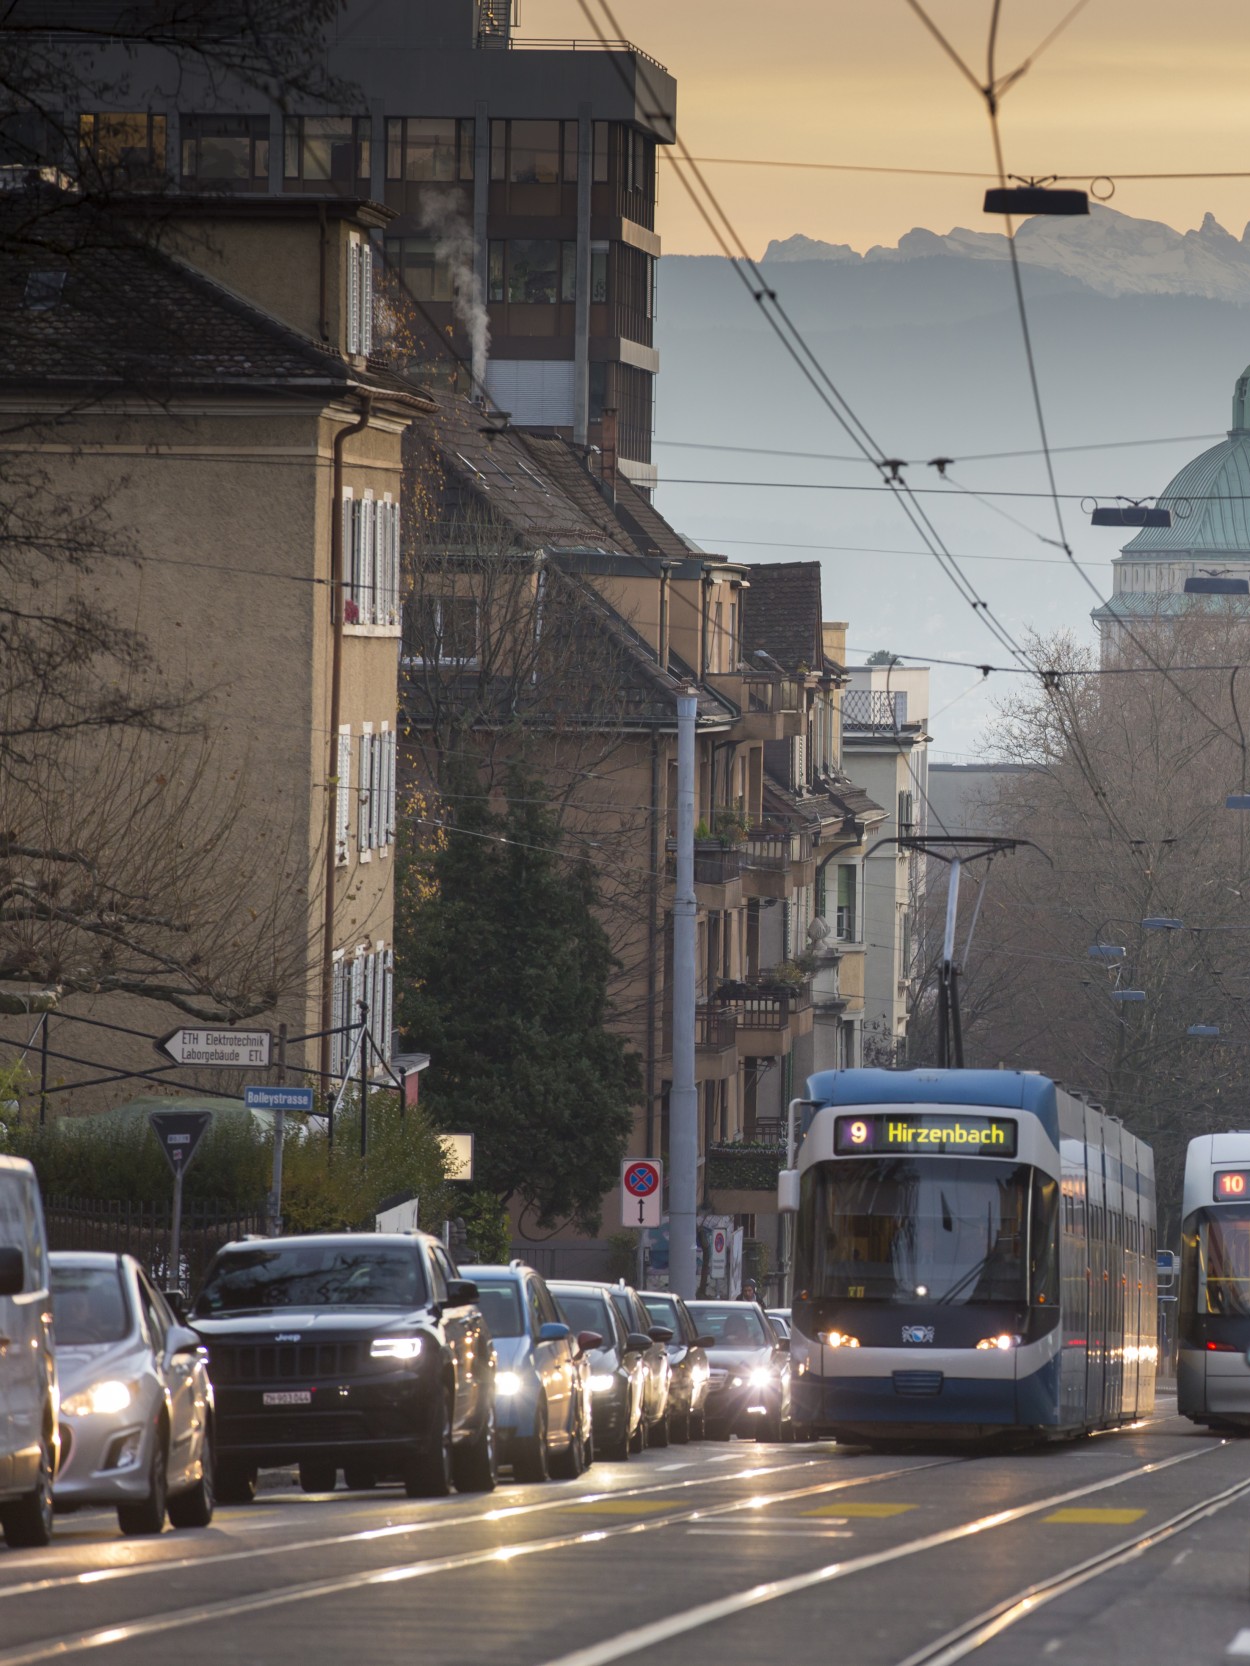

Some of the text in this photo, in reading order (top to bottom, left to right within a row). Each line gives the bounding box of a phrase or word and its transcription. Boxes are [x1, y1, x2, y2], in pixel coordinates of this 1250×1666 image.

[182, 1032, 264, 1047] ETH Elektrotechnik
[181, 1047, 264, 1063] Laborgebäude ETL
[248, 1091, 309, 1106] Bolleystrasse
[850, 1121, 1004, 1144] 9 Hirzenbach
[1222, 1175, 1244, 1193] 10
[275, 1333, 301, 1343] Jeep
